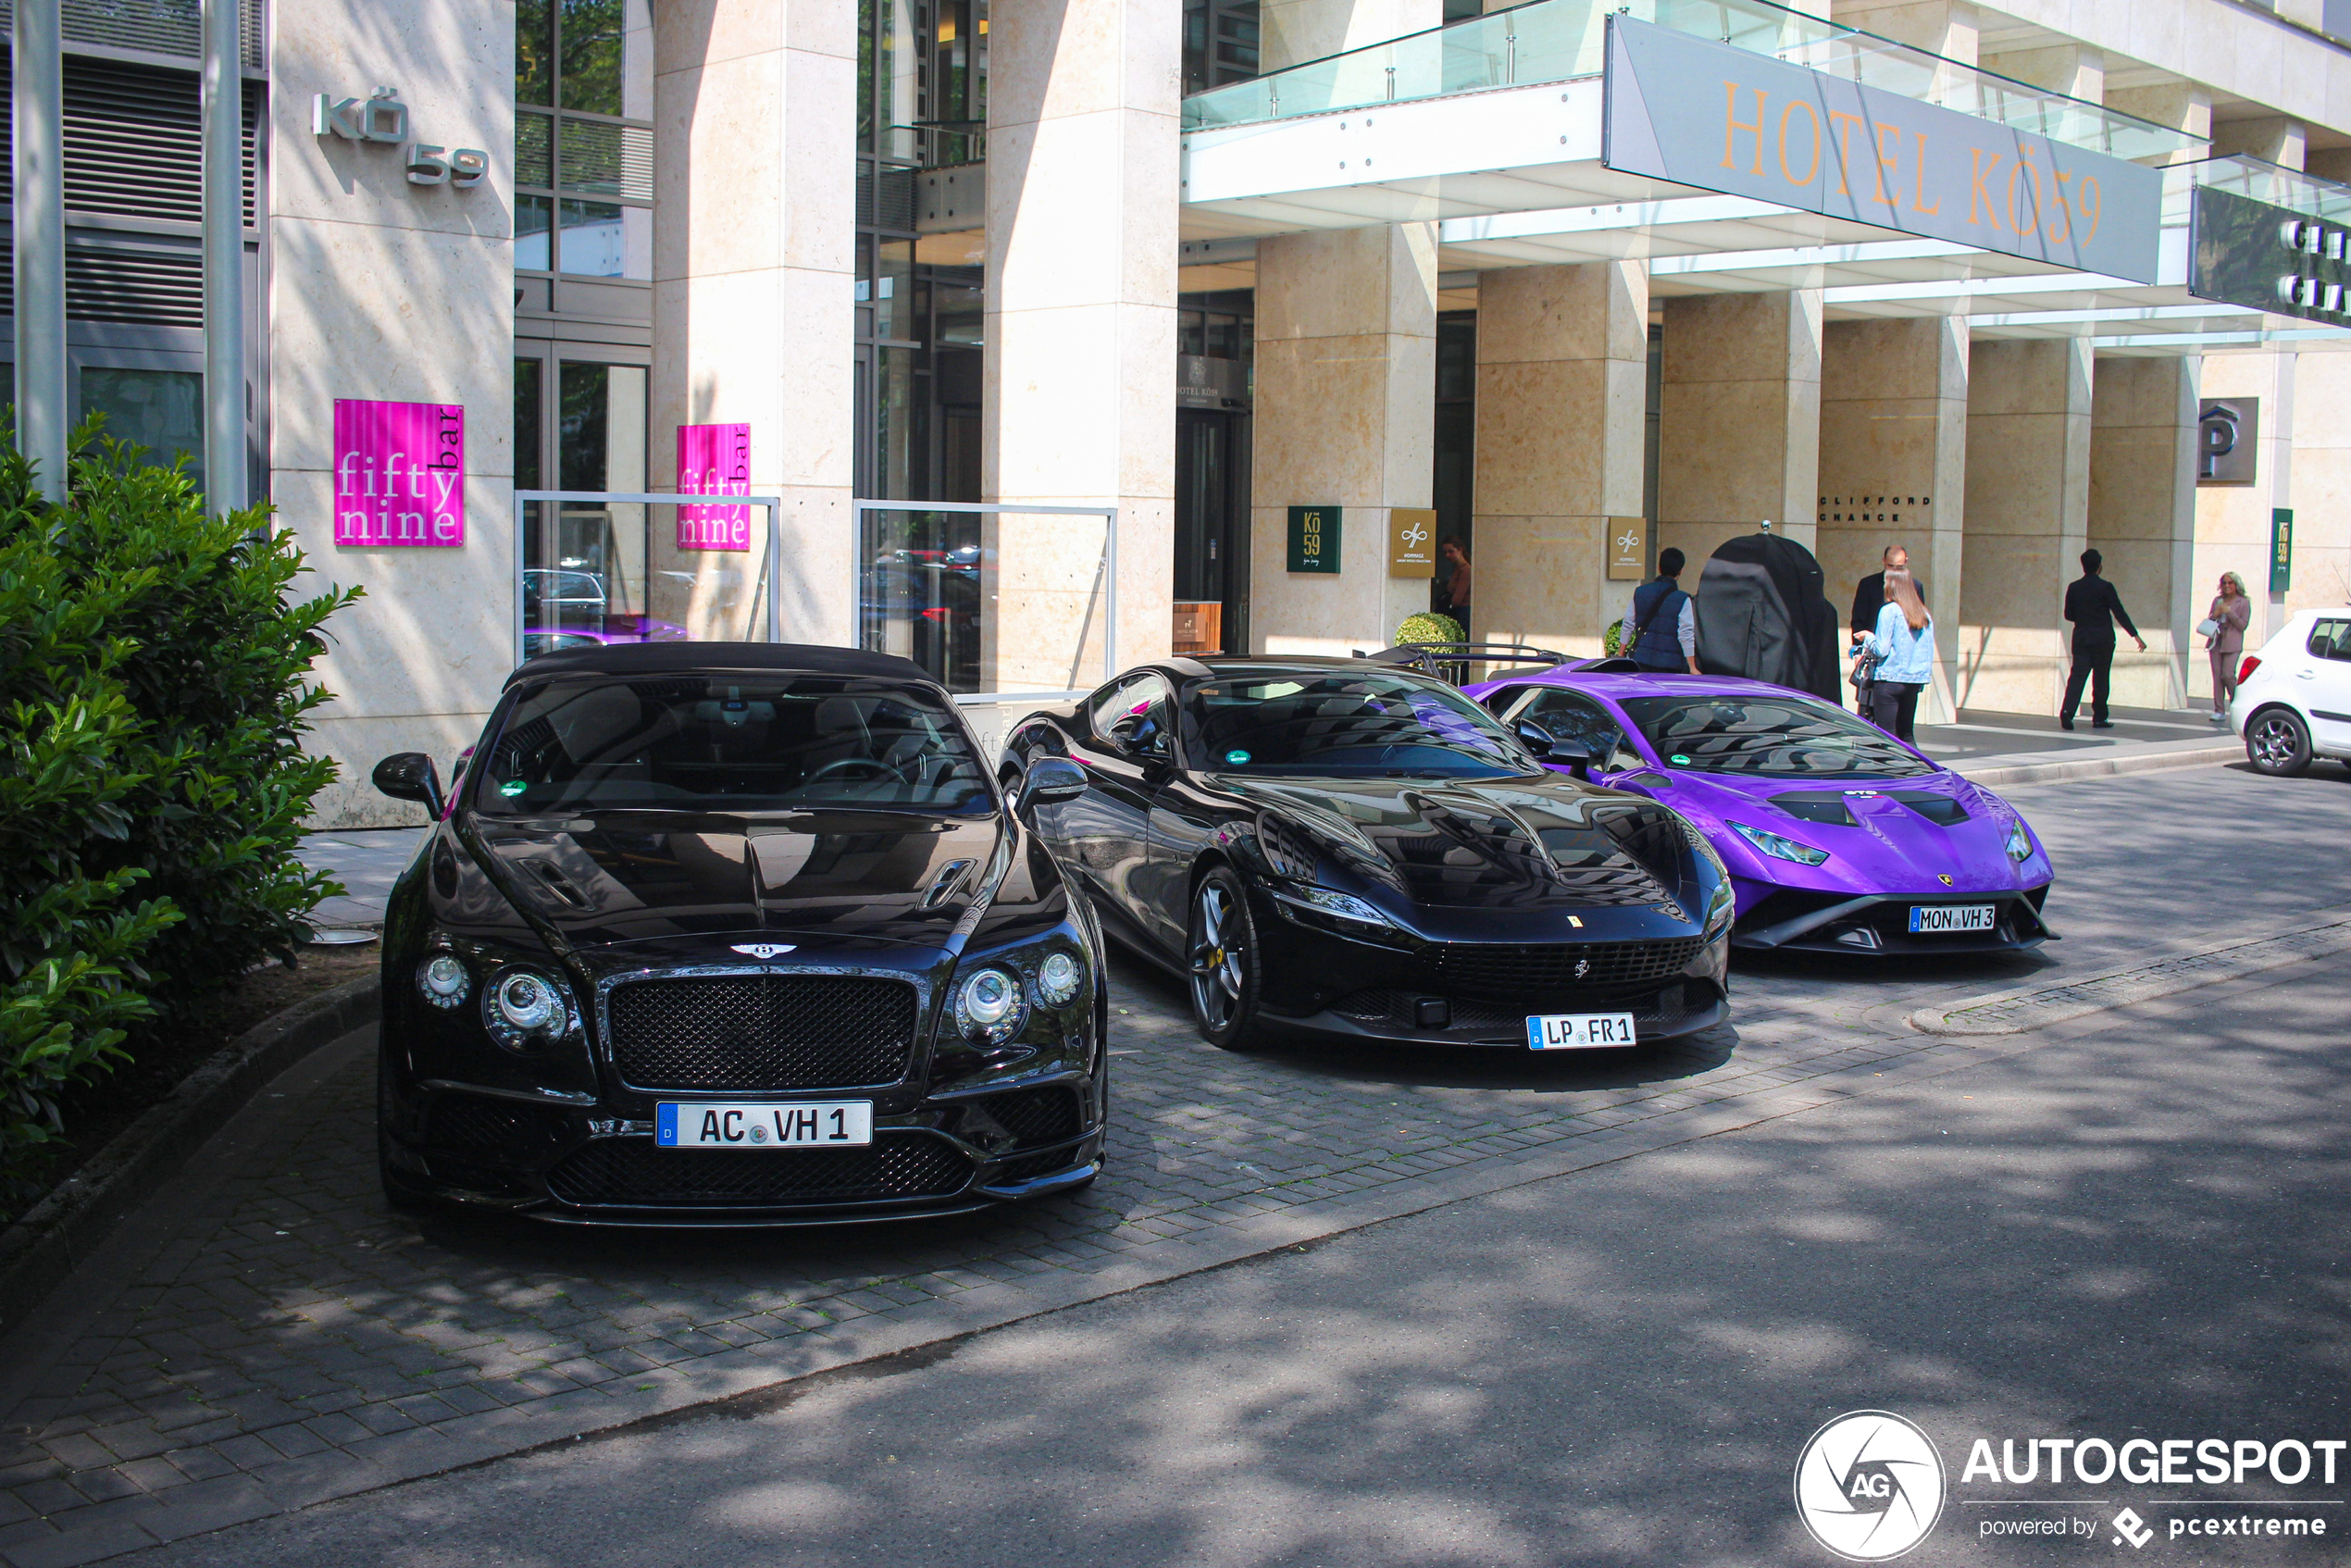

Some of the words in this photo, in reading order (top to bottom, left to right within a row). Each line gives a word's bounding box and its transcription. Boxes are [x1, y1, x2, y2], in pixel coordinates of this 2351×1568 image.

[313, 86, 409, 143] KÖ
[407, 143, 491, 188] 59
[1719, 80, 1943, 217] HOTEL
[1966, 142, 2102, 249] KÖ59
[427, 407, 459, 471] bar
[728, 427, 748, 482] bar
[338, 451, 459, 514] fifty
[679, 467, 748, 520] fifty
[1819, 496, 1931, 505] CLIFFORD
[341, 499, 455, 540] nine
[680, 509, 745, 544] nine
[1819, 513, 1899, 522] CHANCE
[1303, 534, 1321, 555] 59
[1920, 910, 1953, 929] MON
[1961, 909, 1982, 927] VH
[1984, 908, 1994, 927] 3
[1547, 1020, 1573, 1044] LP
[664, 1128, 672, 1139] D
[700, 1109, 745, 1142] AC
[774, 1108, 818, 1141] VH
[828, 1108, 849, 1140] 1
